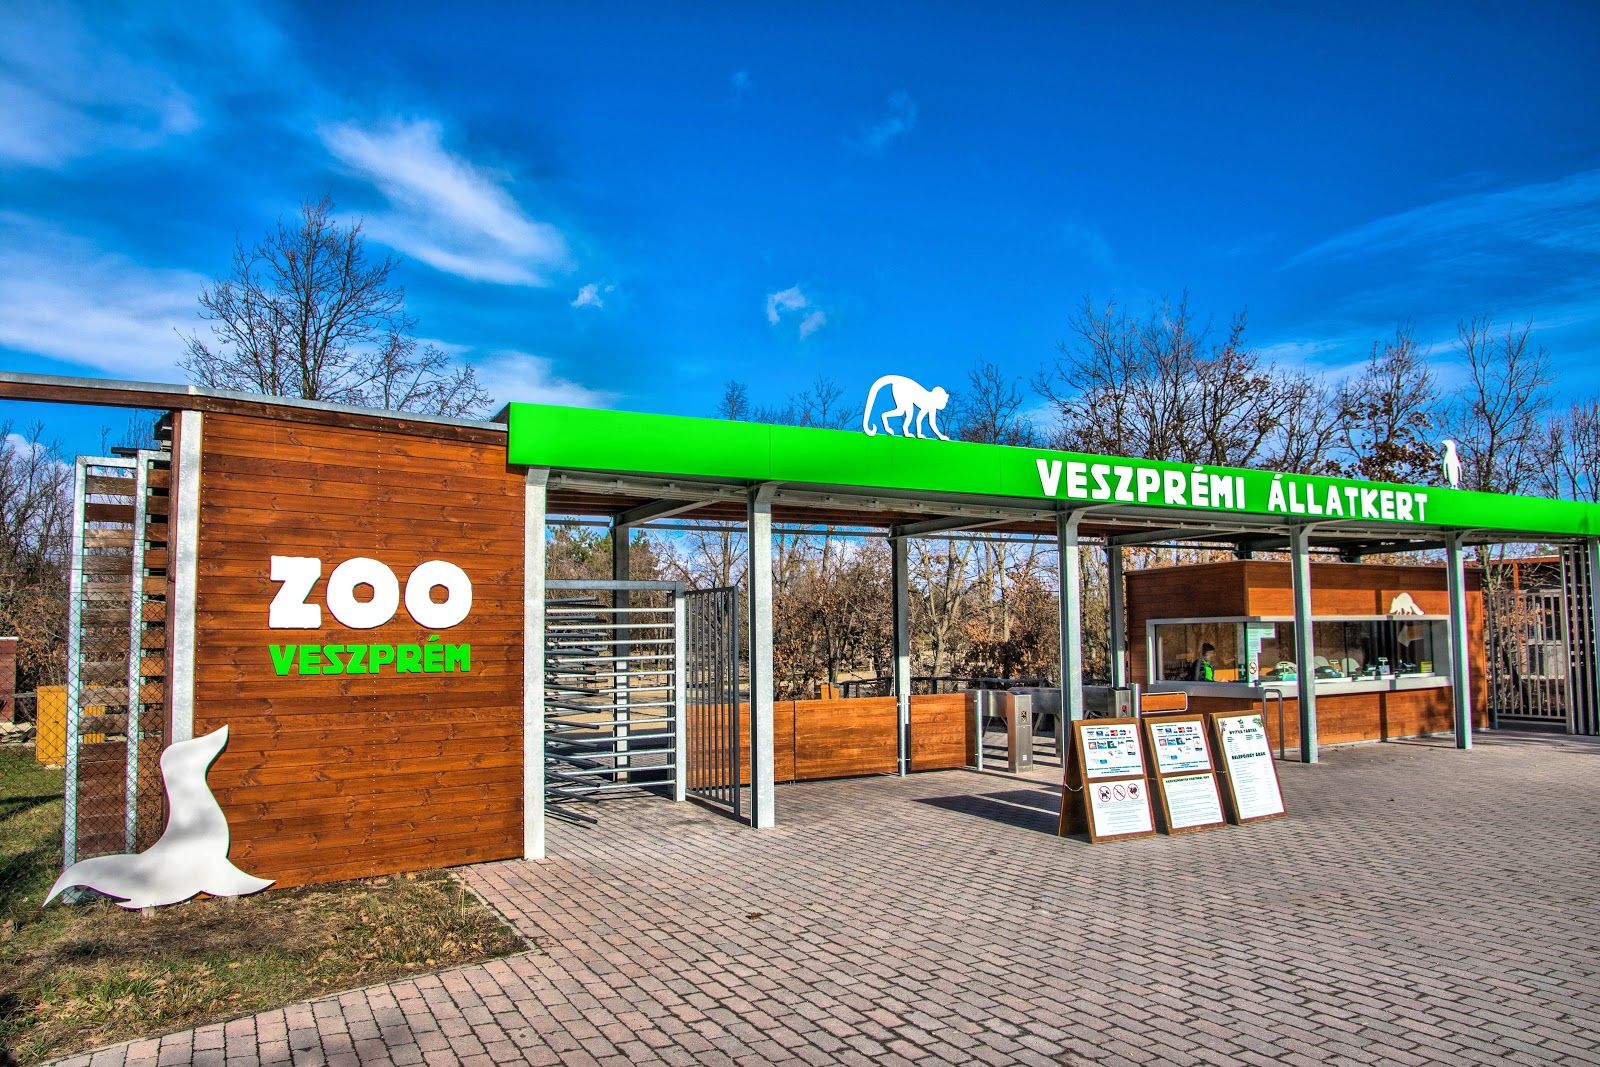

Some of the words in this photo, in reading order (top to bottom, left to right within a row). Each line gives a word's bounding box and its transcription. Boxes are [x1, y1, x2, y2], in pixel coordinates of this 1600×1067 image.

[1036, 459, 1246, 510] VESZPRÉMI
[1268, 473, 1428, 522] ÁLLATKERT
[269, 555, 473, 630] ZOO
[269, 634, 471, 676] VESZPRÉM
